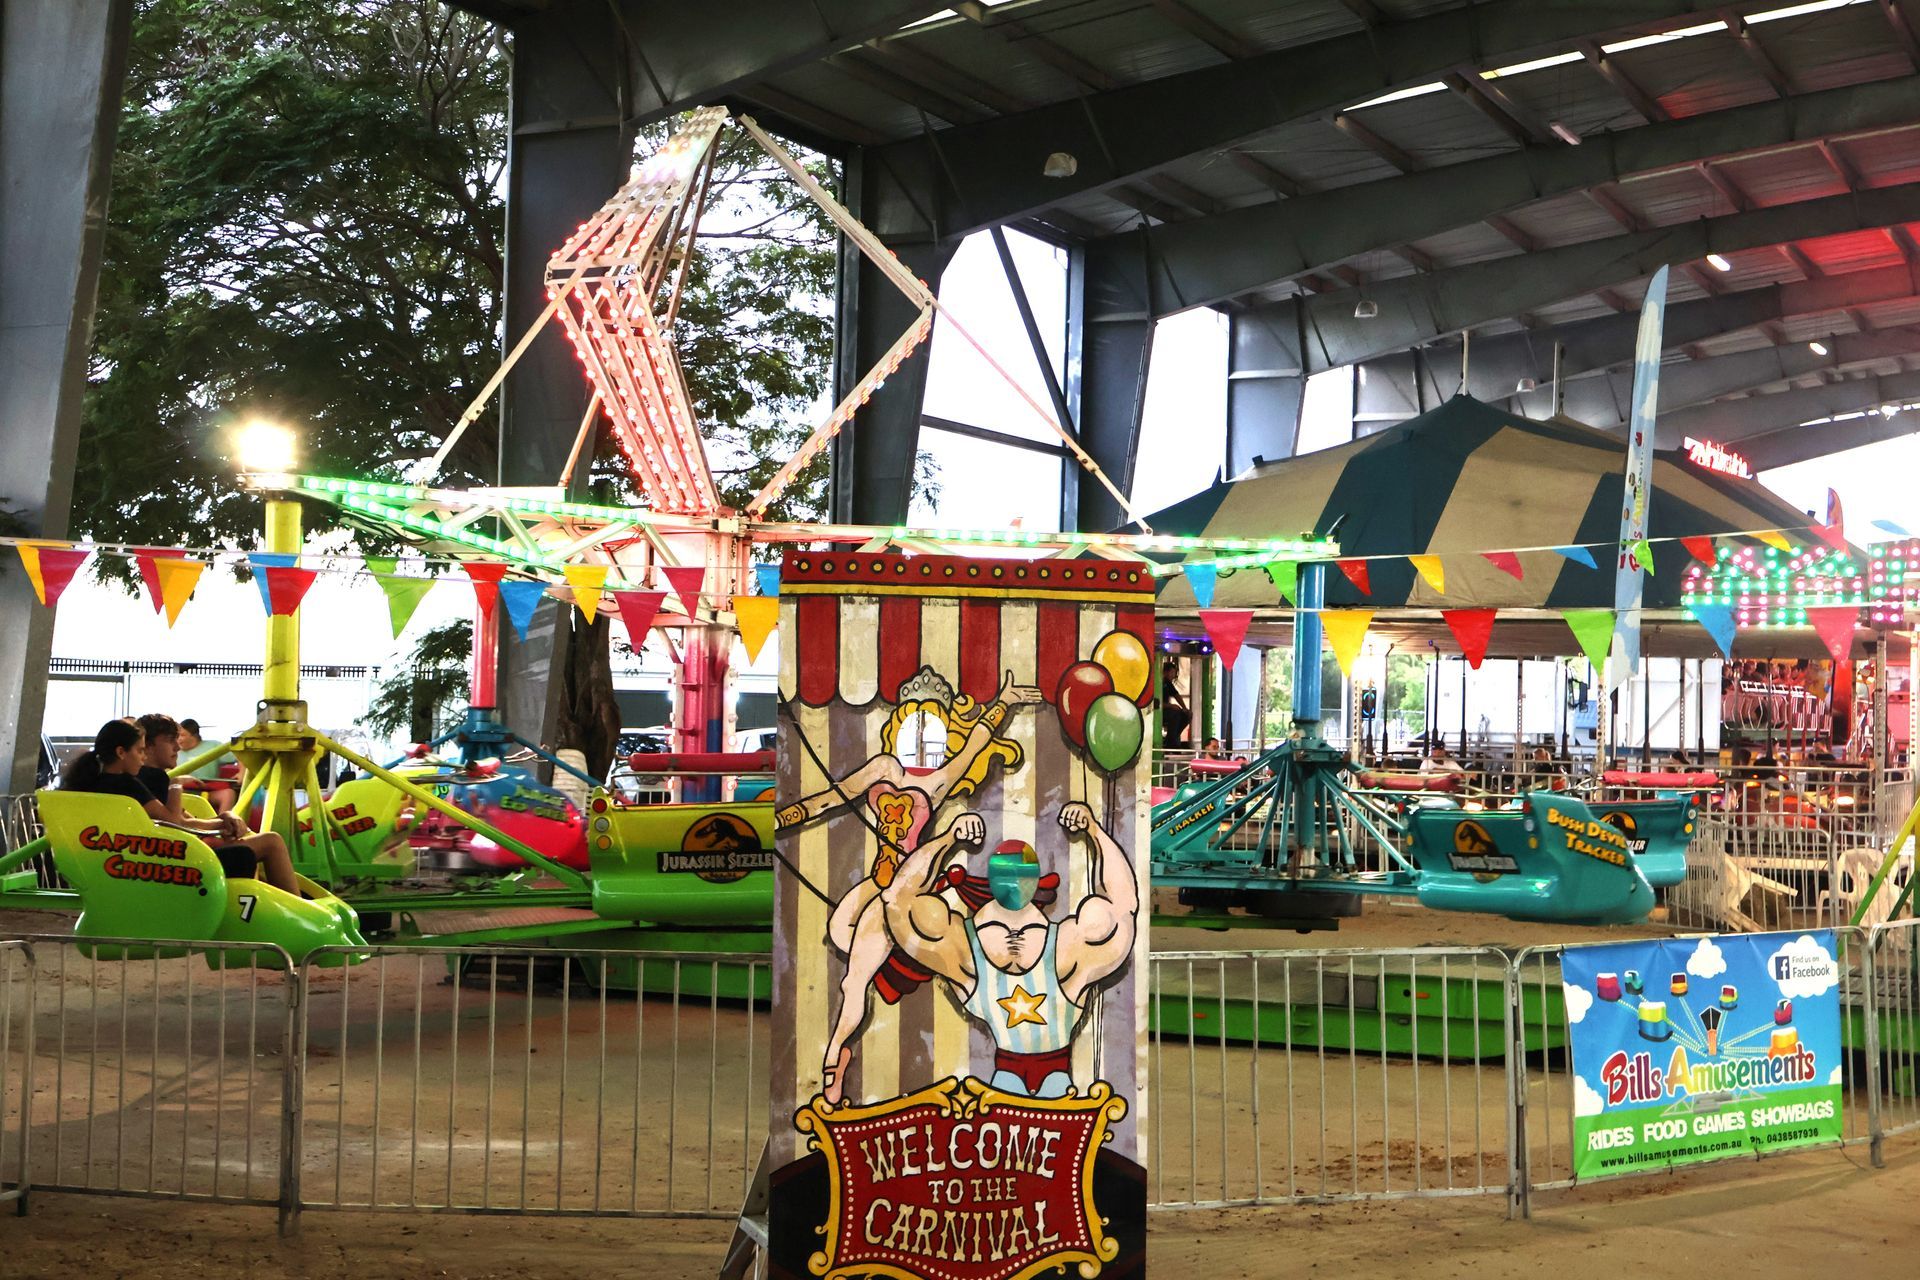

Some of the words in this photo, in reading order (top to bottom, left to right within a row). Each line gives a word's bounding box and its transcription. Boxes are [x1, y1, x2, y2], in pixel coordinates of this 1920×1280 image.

[1547, 808, 1585, 833] BUSH
[79, 825, 187, 859] CAPTURE
[1566, 832, 1626, 866] TRACKER
[103, 854, 203, 886] CRUISER
[238, 895, 257, 923] 7
[1792, 964, 1830, 978] Facebook
[1602, 1051, 1661, 1105] Bills
[1664, 1043, 1816, 1096] Amusements
[1588, 1126, 1635, 1151] RIDES
[1643, 1119, 1688, 1143] FOOD
[1693, 1111, 1746, 1136] GAMES
[1751, 1100, 1835, 1128] SHOWBAGS
[859, 1122, 1062, 1183] WELCOME
[1600, 1140, 1742, 1168] www.billsamusements.com.au
[928, 1179, 964, 1204] TO
[970, 1177, 1018, 1201] THE
[864, 1198, 1060, 1262] CARNIVAL
